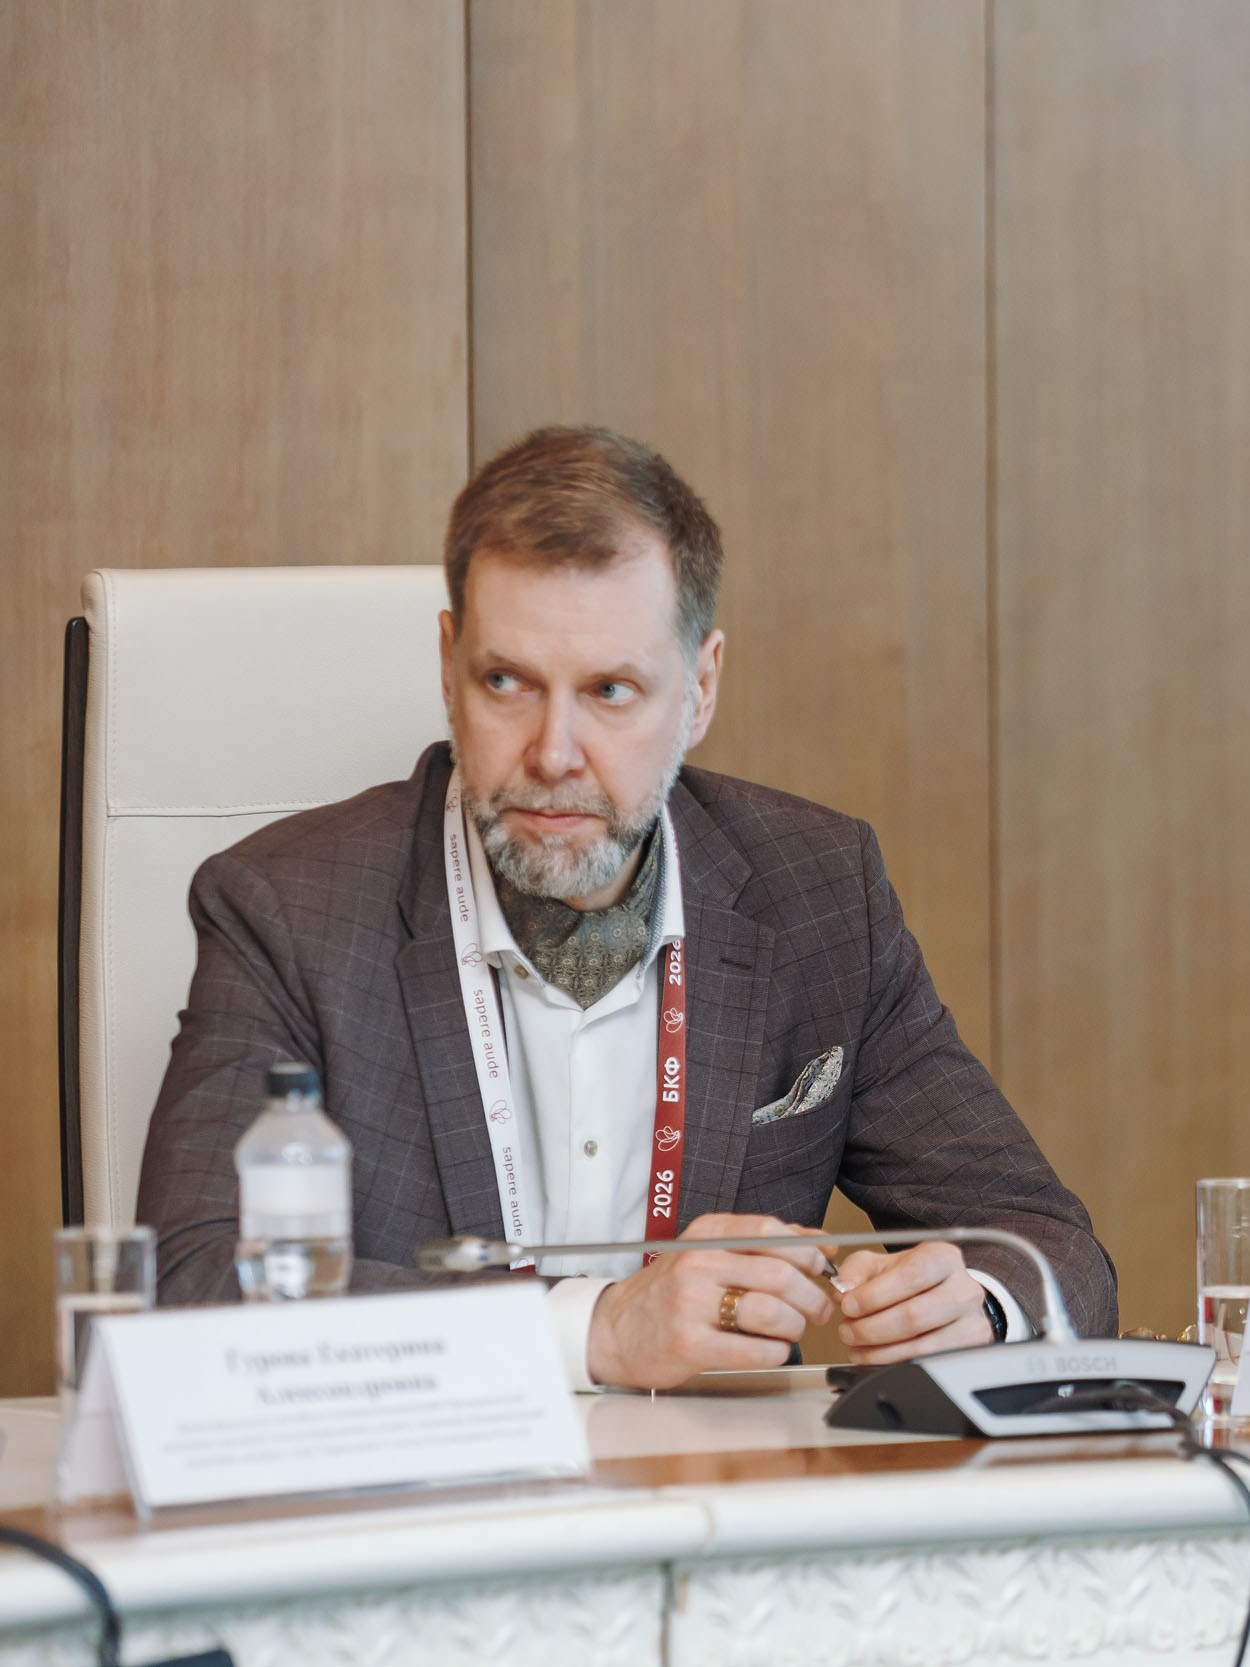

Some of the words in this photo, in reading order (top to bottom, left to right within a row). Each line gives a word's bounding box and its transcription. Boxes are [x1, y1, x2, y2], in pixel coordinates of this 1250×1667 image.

[449, 833, 463, 885] sapere
[456, 886, 469, 923] aude
[669, 939, 682, 985] 2026
[473, 988, 493, 1041] sapere
[483, 1042, 498, 1079] aude
[663, 1055, 680, 1103] БКФ
[503, 1146, 518, 1196] sapere
[653, 1168, 674, 1218] 2026
[509, 1199, 523, 1237] aude
[1056, 1356, 1118, 1373] BOSCH
